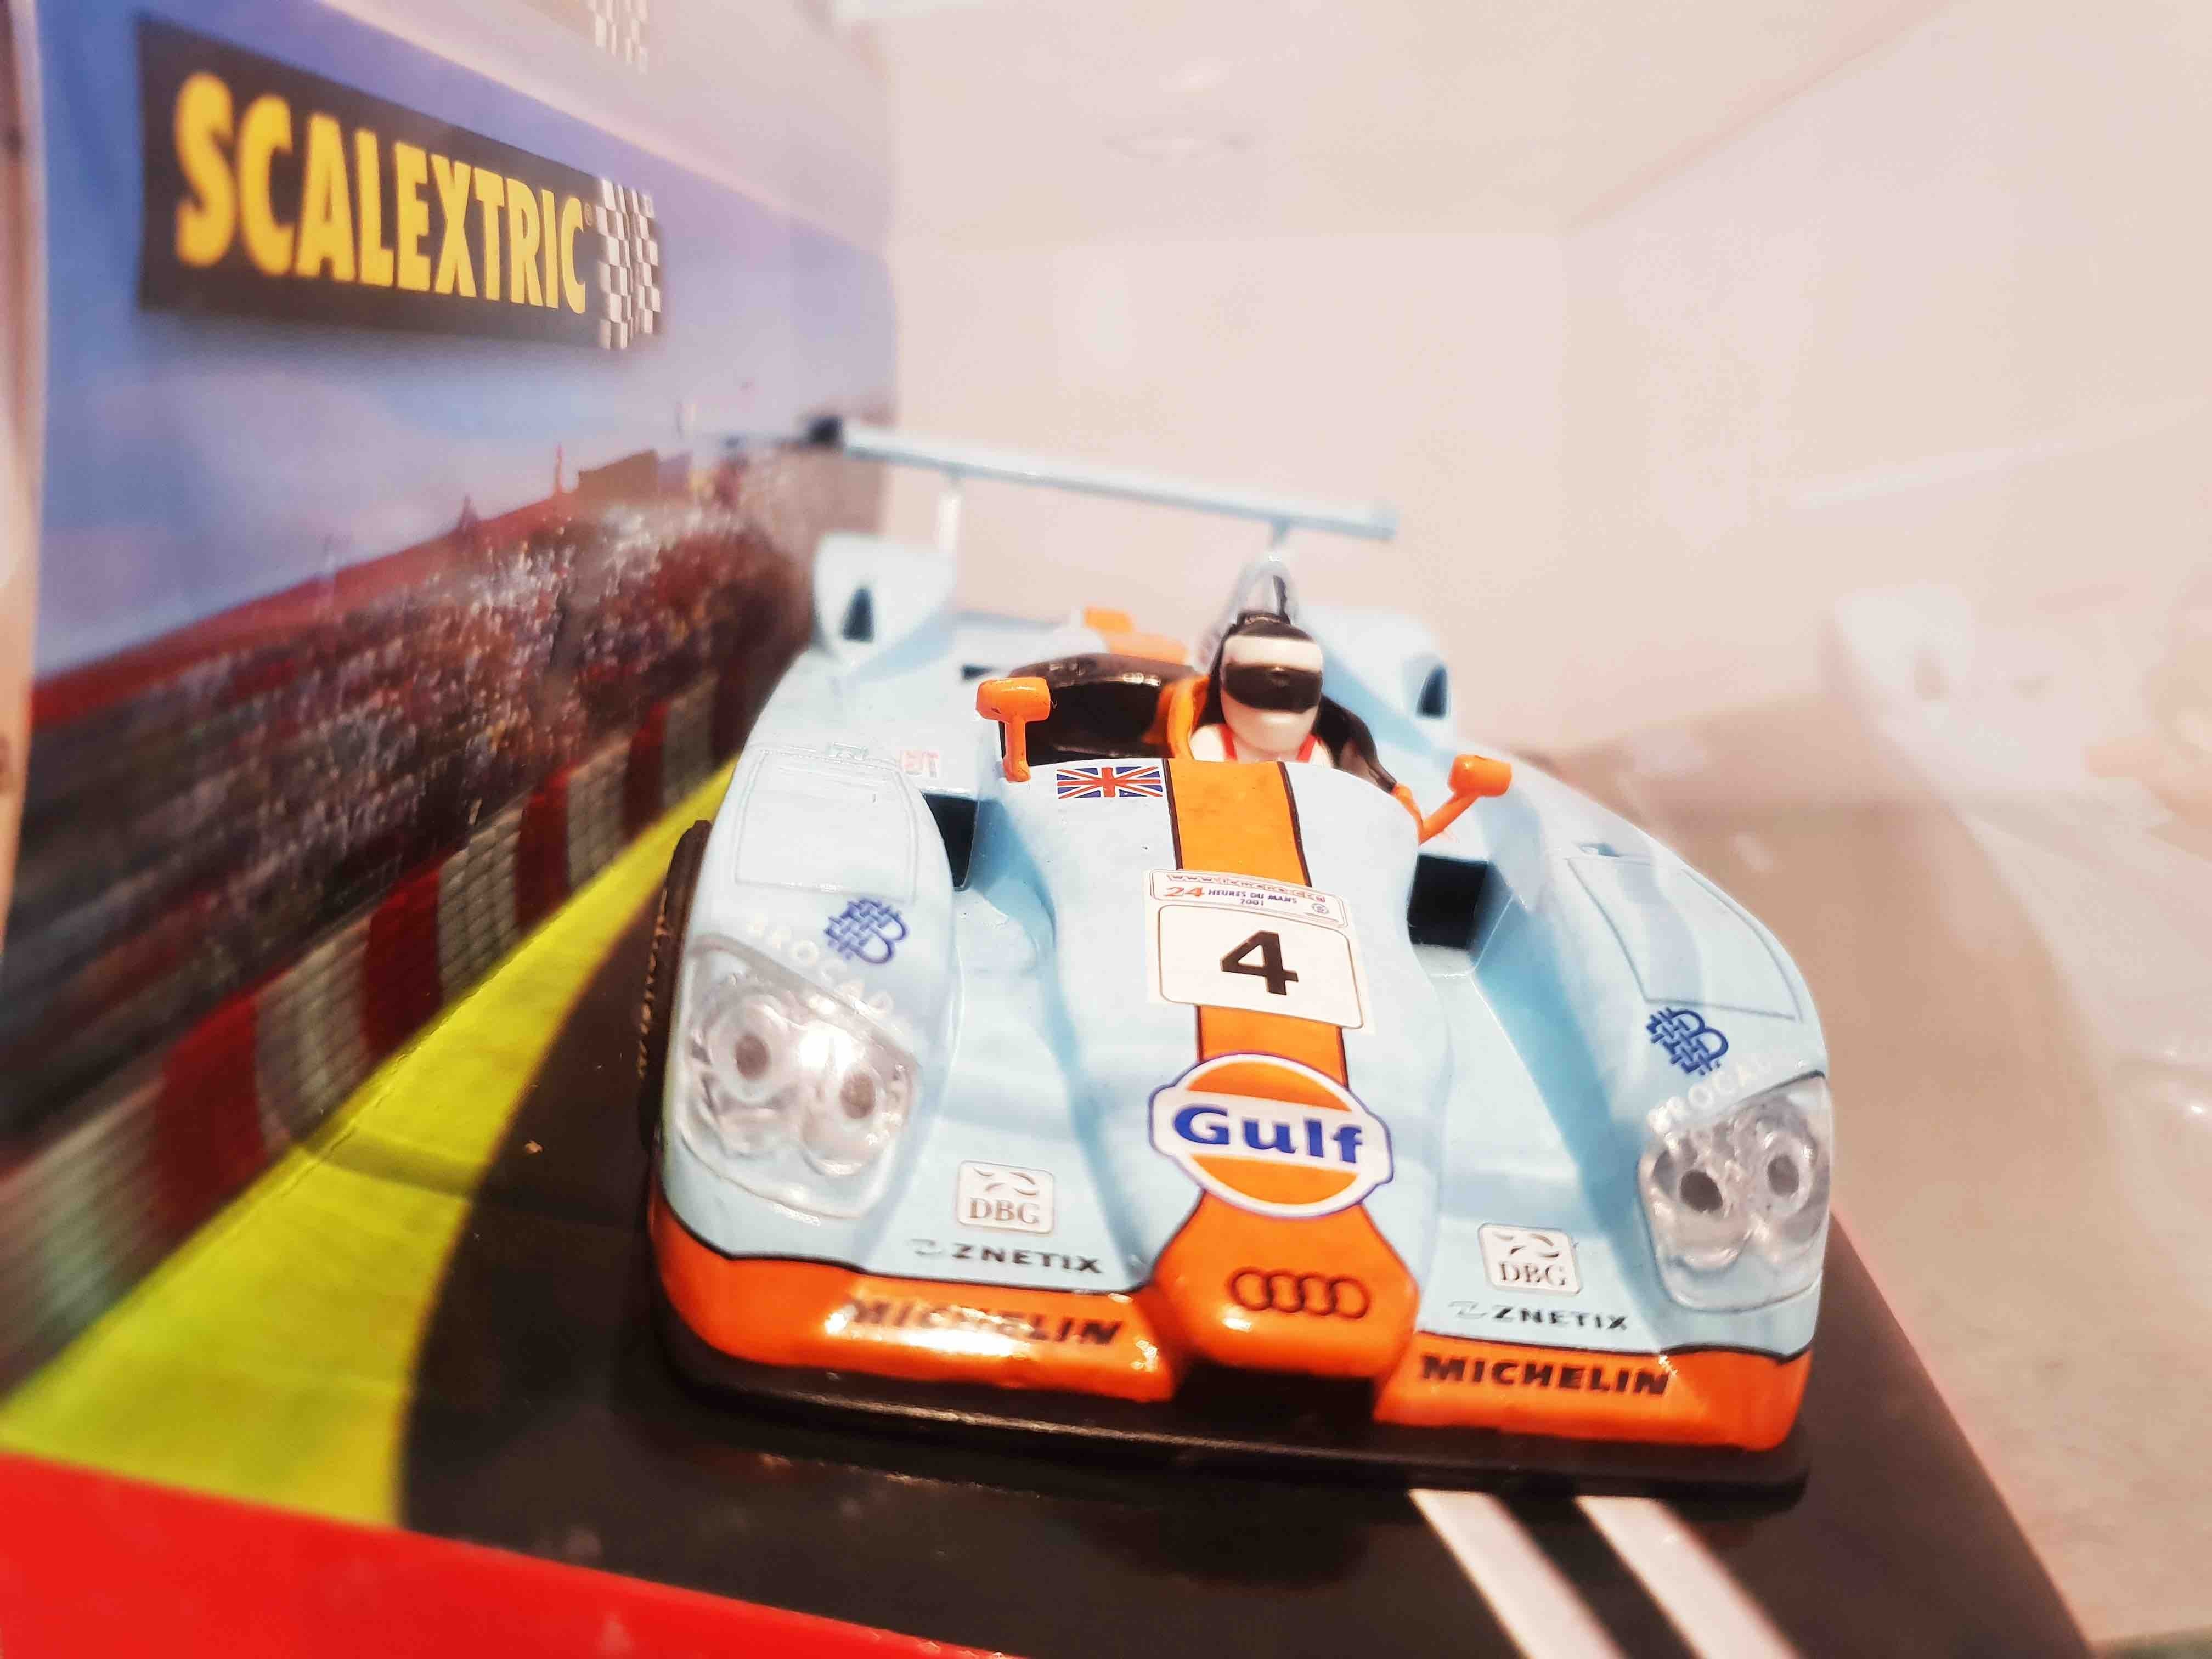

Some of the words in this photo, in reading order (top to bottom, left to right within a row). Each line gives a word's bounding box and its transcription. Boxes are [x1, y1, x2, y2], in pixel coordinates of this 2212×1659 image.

[174, 72, 586, 314] SCALEXTRIC
[1164, 886, 1205, 898] 24
[1208, 888, 1246, 898] HEURES
[1267, 894, 1298, 904] MANS
[1240, 898, 1265, 906] 2001
[1220, 930, 1299, 995] 4
[1173, 1104, 1363, 1164] Gulf
[969, 1197, 1040, 1225] DBG
[952, 1242, 1102, 1274] ZNETIX
[1498, 1262, 1567, 1286] DBG
[1492, 1305, 1628, 1330] ZNETIX
[1421, 1355, 1670, 1396] MICHELIN
